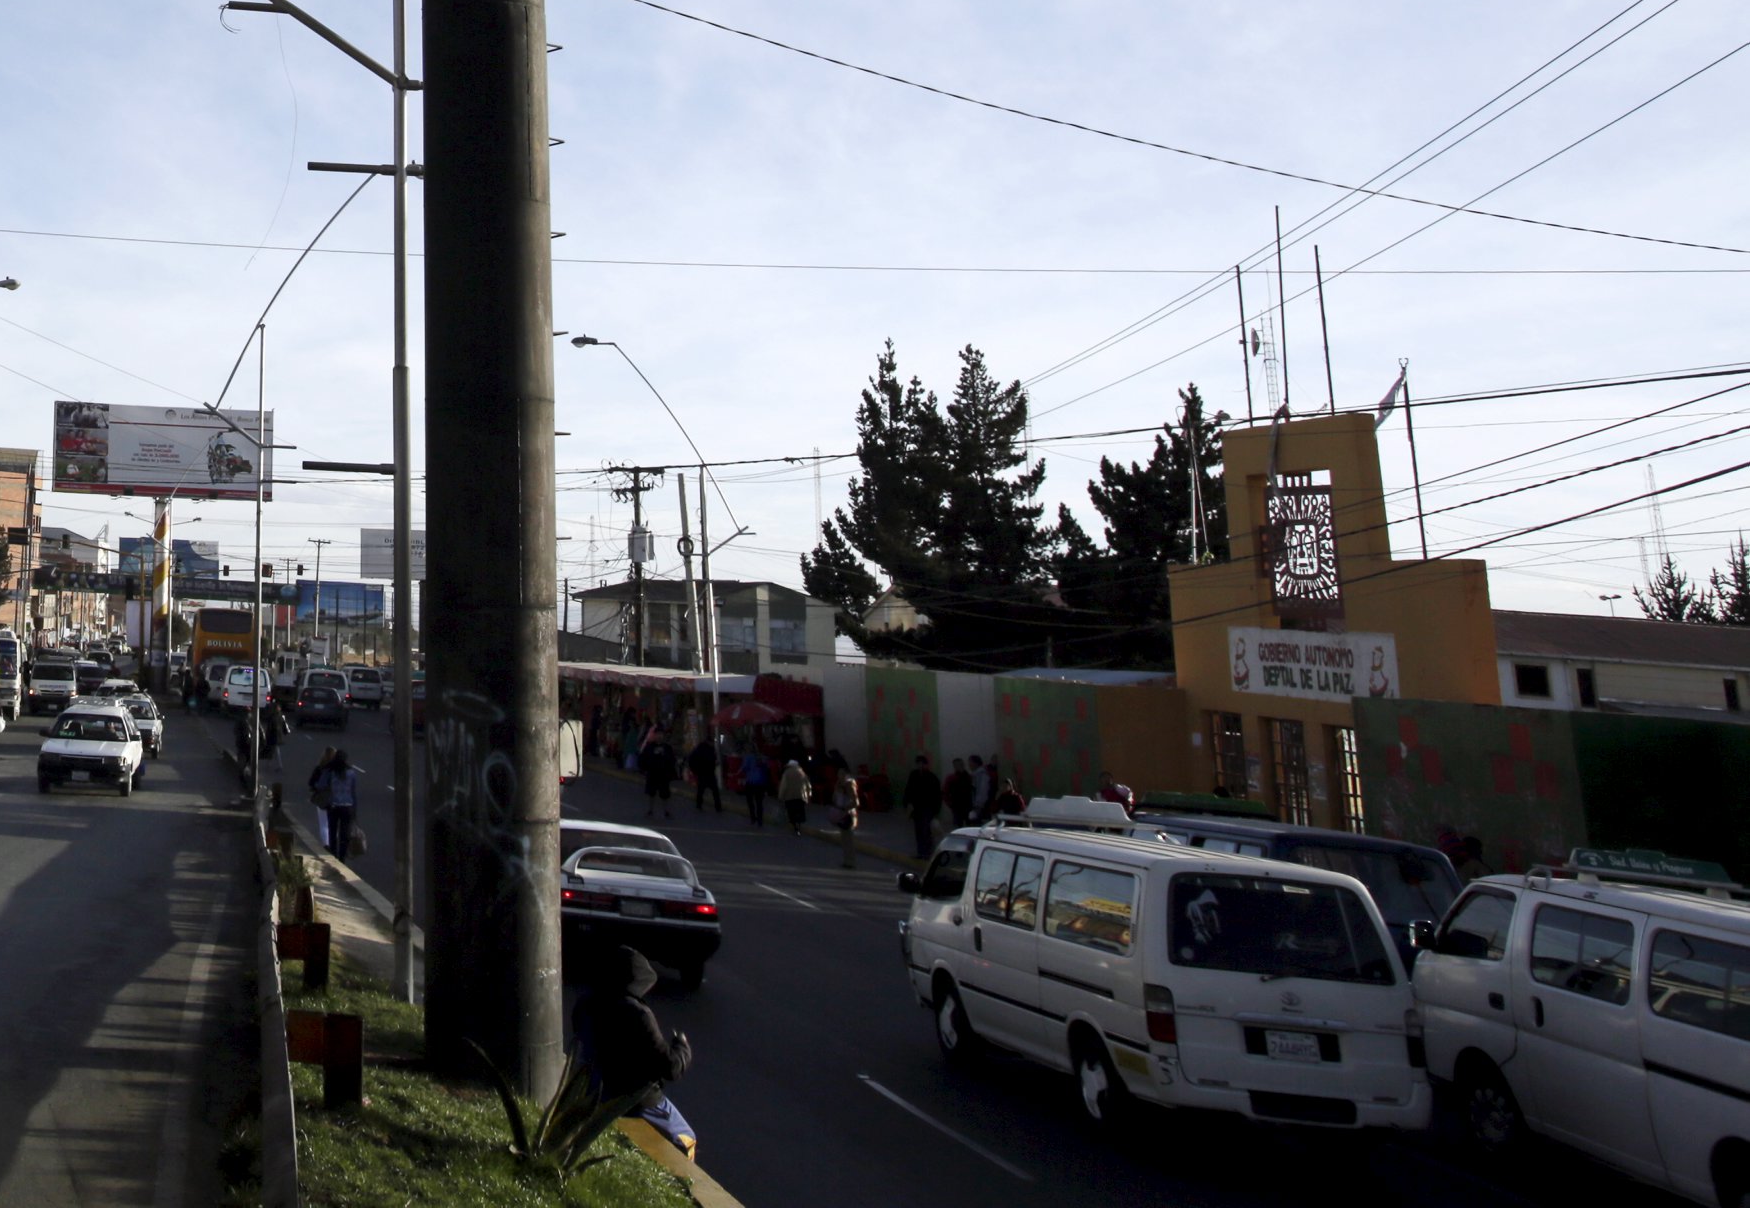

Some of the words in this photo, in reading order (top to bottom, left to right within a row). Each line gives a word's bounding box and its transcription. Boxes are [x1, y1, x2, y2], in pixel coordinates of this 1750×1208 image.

[207, 639, 243, 649] BOLIVIA
[1258, 642, 1301, 664] GOBIERNO
[1305, 644, 1354, 669] AUTONOMO
[1300, 668, 1314, 690] DE
[1317, 670, 1331, 693] LA
